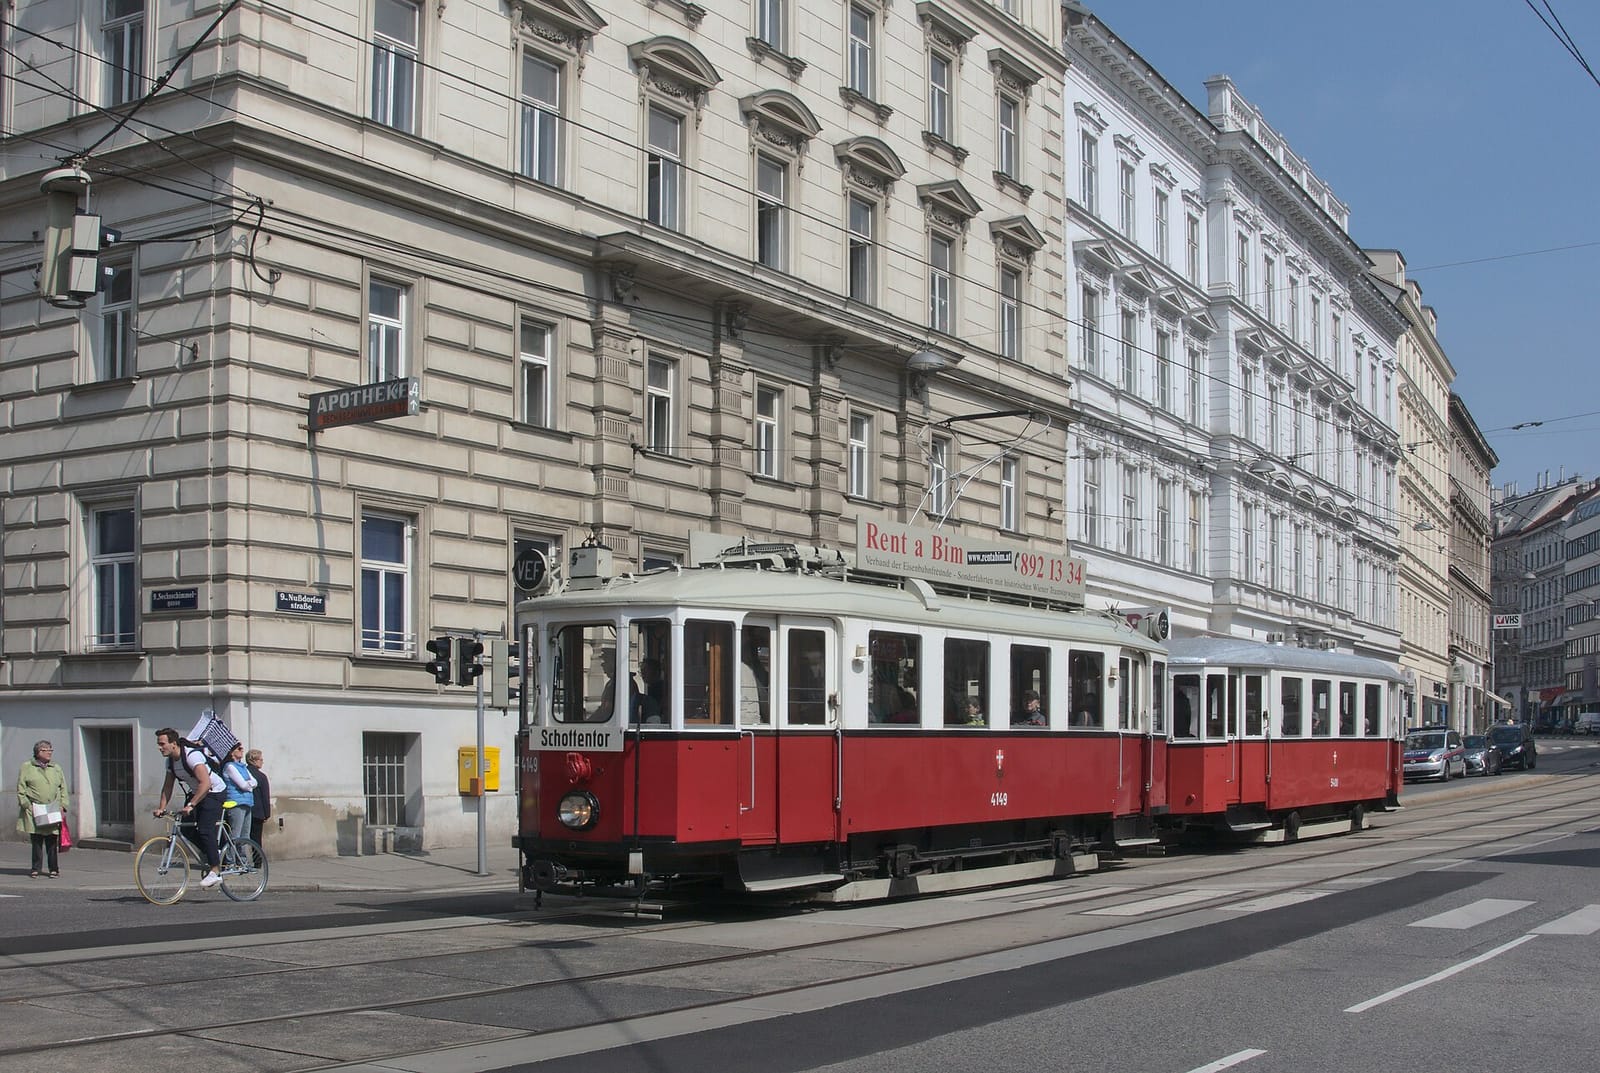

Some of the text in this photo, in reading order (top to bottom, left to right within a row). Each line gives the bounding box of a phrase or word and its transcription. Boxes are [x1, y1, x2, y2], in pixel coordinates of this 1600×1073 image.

[317, 381, 408, 413] APOTHEKE
[865, 522, 963, 564] Rent a Bim
[517, 559, 542, 581] VEF
[865, 555, 890, 568] Verband
[891, 559, 901, 569] der
[903, 561, 952, 577] Eisenbahnfreunde
[1020, 552, 1082, 585] 892 13 34
[288, 593, 323, 604] Nußdorfer
[290, 602, 313, 611] straße
[1504, 615, 1519, 624] VHS
[540, 728, 611, 748] Schottentor
[521, 756, 538, 773] 4149
[990, 791, 1008, 807] 4149
